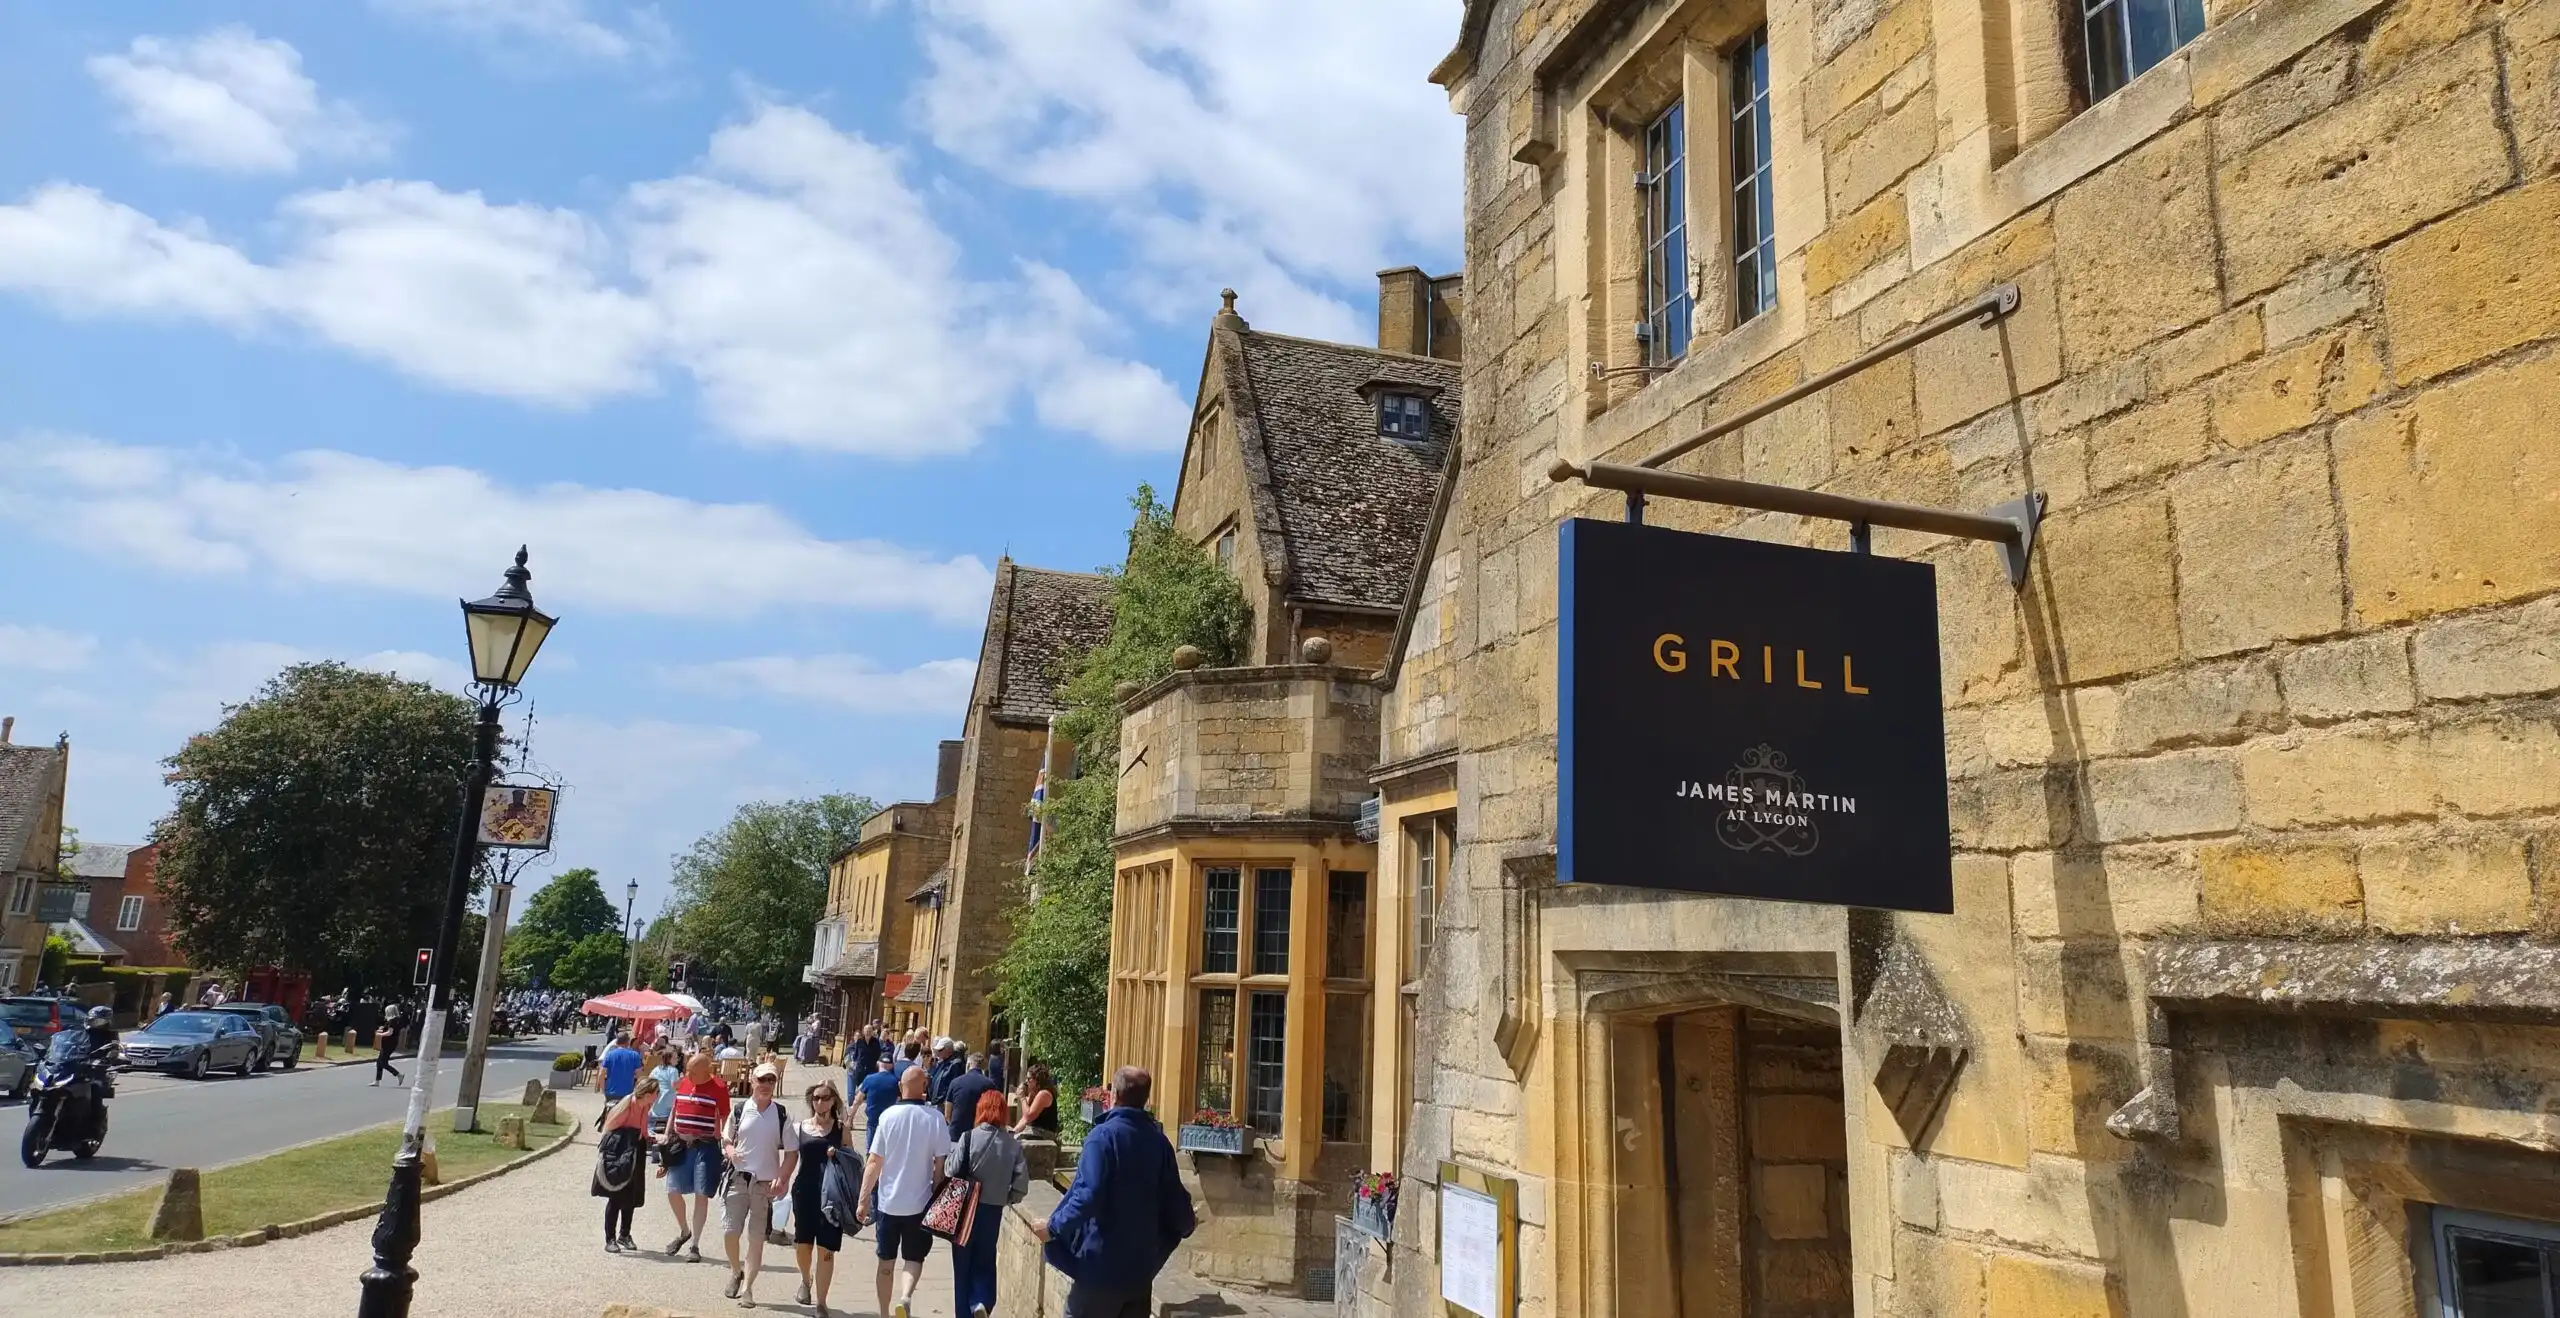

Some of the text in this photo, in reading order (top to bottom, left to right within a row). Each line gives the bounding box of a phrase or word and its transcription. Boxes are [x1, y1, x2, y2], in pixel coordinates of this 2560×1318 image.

[1653, 633, 1869, 695] GRILL
[1676, 780, 1857, 814] JAMES MARTIN
[1727, 809, 1808, 827] AT LYGON
